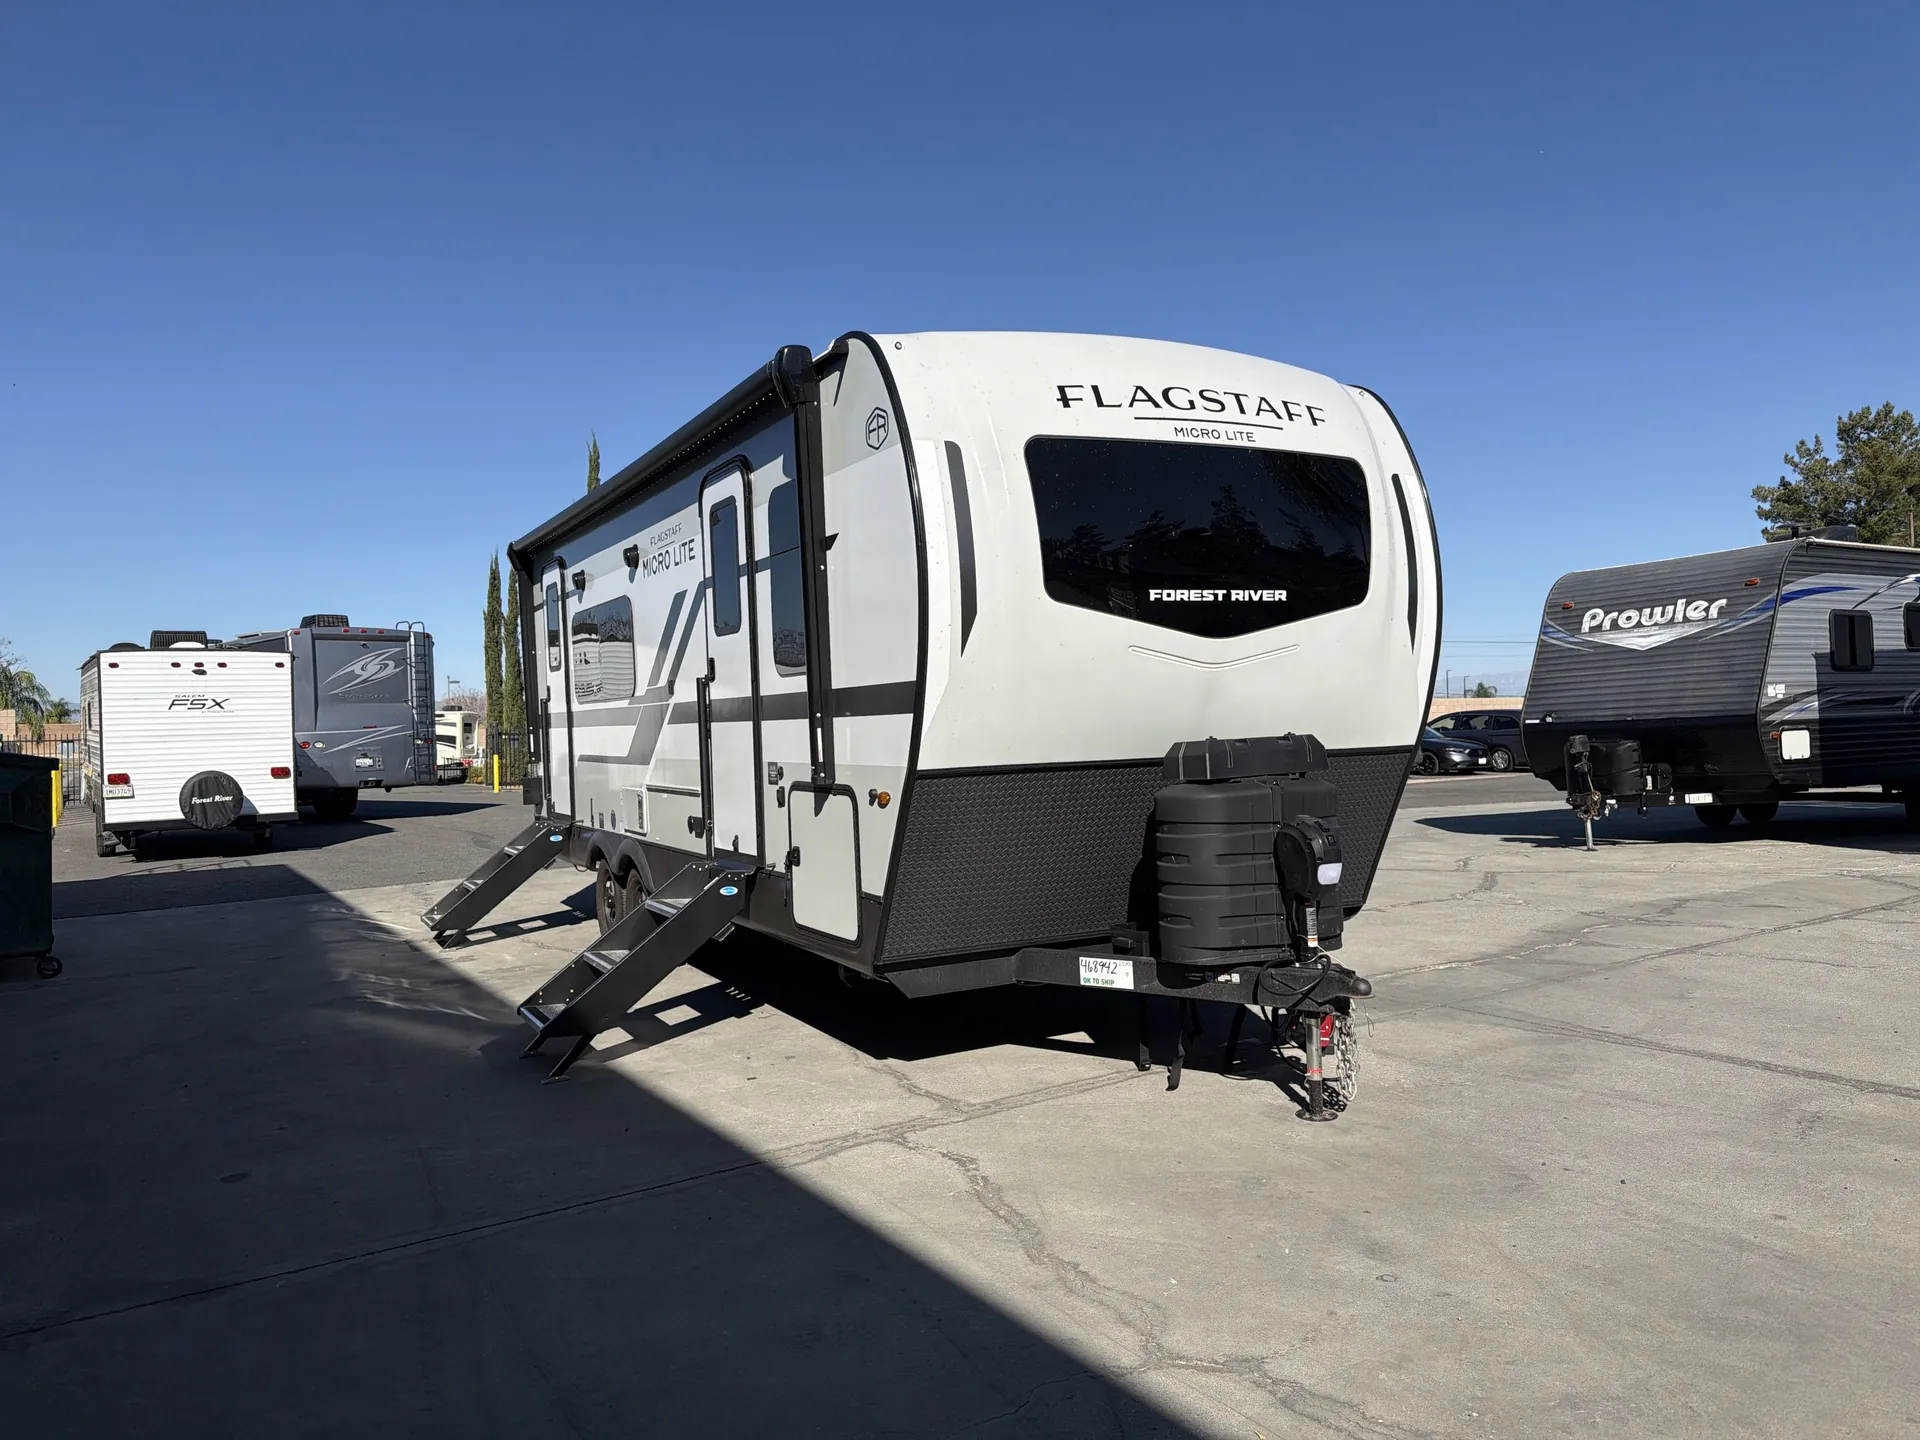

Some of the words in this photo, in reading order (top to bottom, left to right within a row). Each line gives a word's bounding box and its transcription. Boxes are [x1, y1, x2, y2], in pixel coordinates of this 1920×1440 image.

[1056, 384, 1326, 427] FLAGSTAFF
[1174, 426, 1221, 440] MICRO
[1225, 430, 1256, 443] LITE
[650, 522, 682, 547] FLAGSTAFF
[642, 549, 671, 579] MICRO
[673, 538, 696, 567] LITE
[1149, 589, 1227, 602] FOREST
[1230, 589, 1288, 602] RIVER
[1581, 598, 1727, 633] Prowler
[168, 698, 230, 710] FSX
[1081, 959, 1117, 974] 468942
